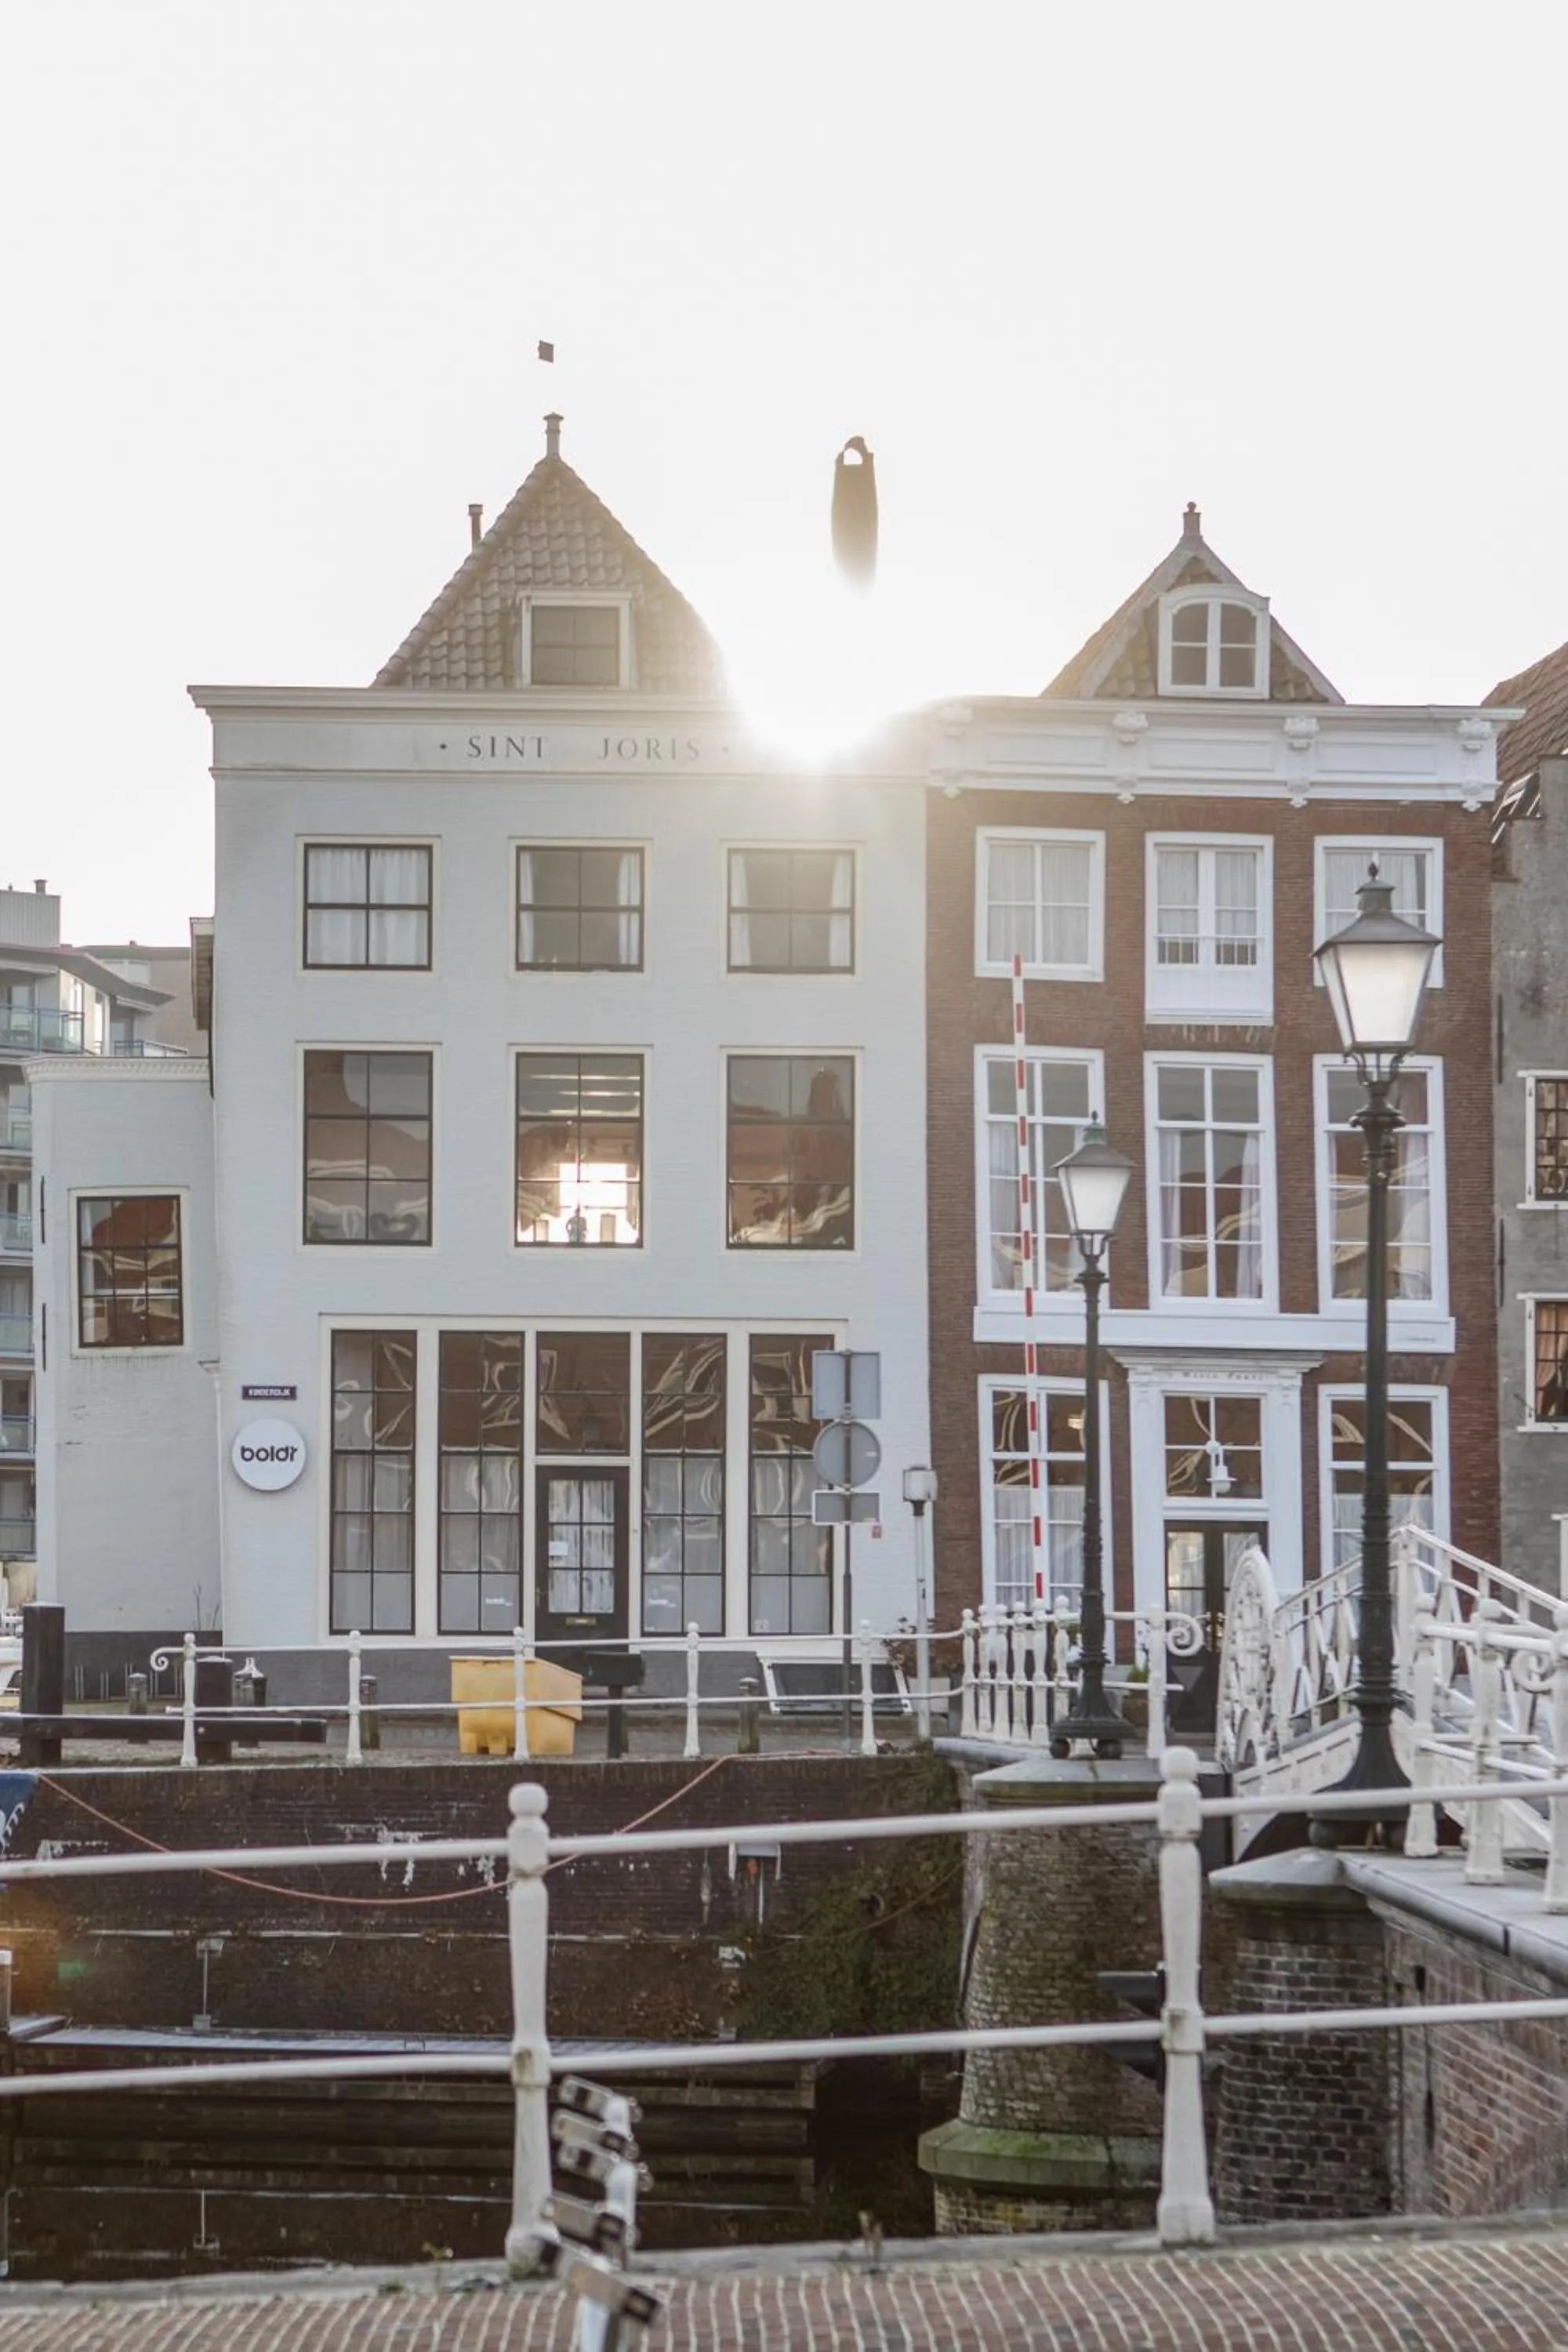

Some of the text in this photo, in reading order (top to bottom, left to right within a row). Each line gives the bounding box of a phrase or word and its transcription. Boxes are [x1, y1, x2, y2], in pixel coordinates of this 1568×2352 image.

[467, 736, 700, 760] SINT JORIS
[241, 1446, 298, 1462] boldr
